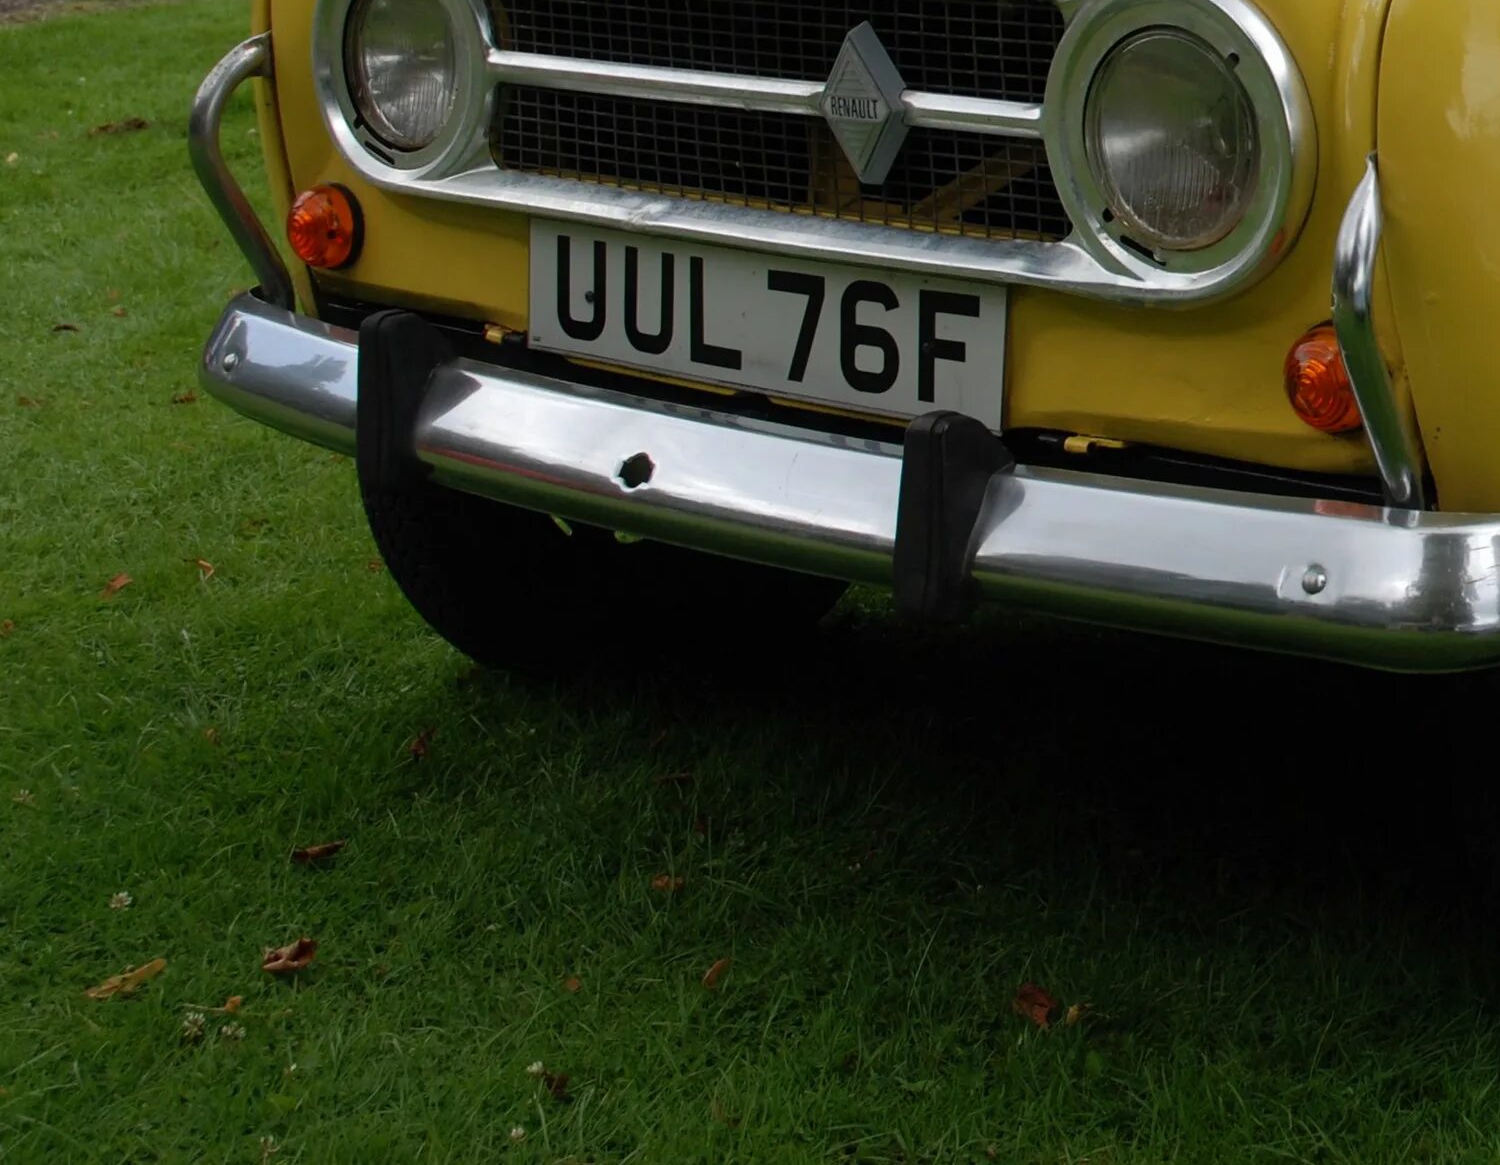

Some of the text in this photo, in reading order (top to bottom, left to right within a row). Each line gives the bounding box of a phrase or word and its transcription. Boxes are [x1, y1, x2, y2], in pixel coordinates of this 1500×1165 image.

[830, 96, 879, 120] RENAULT
[556, 234, 981, 403] UUL 76F
